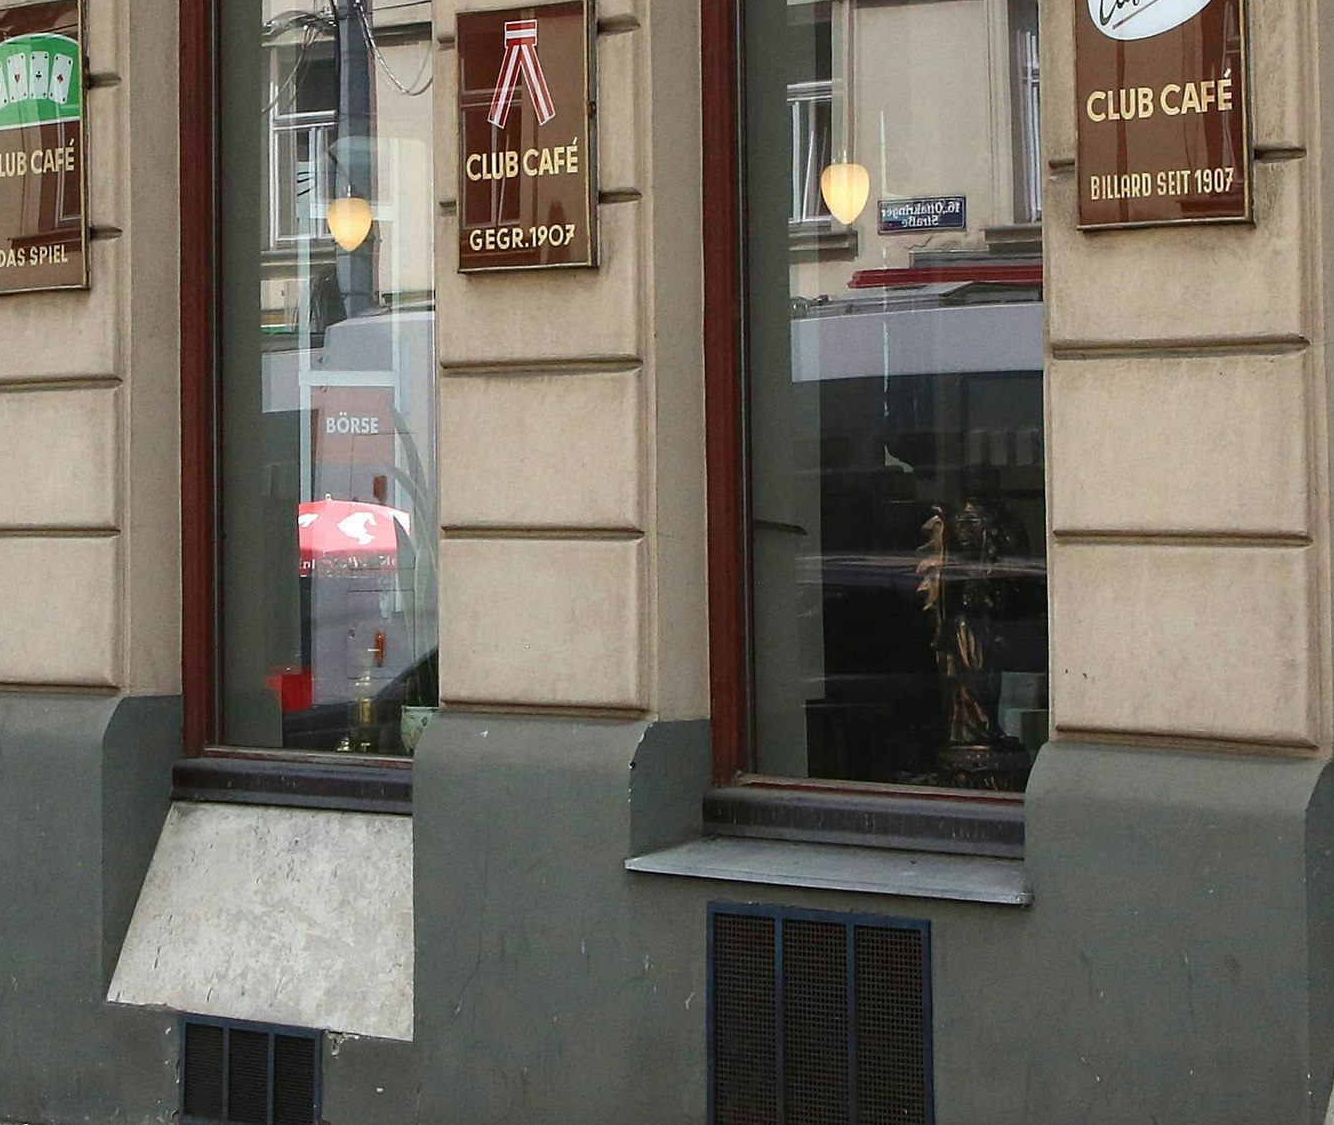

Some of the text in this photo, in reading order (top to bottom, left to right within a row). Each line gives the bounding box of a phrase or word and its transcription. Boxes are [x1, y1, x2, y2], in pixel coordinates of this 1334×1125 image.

[1086, 68, 1233, 123] CLUB CAFÉ
[31, 138, 75, 174] CAFÉ
[466, 136, 578, 181] CLUB CAFÉ
[1090, 166, 1235, 200] BILLARD SEIT 1907
[30, 244, 69, 266] SPIEL
[326, 412, 380, 434] BÖRSE
